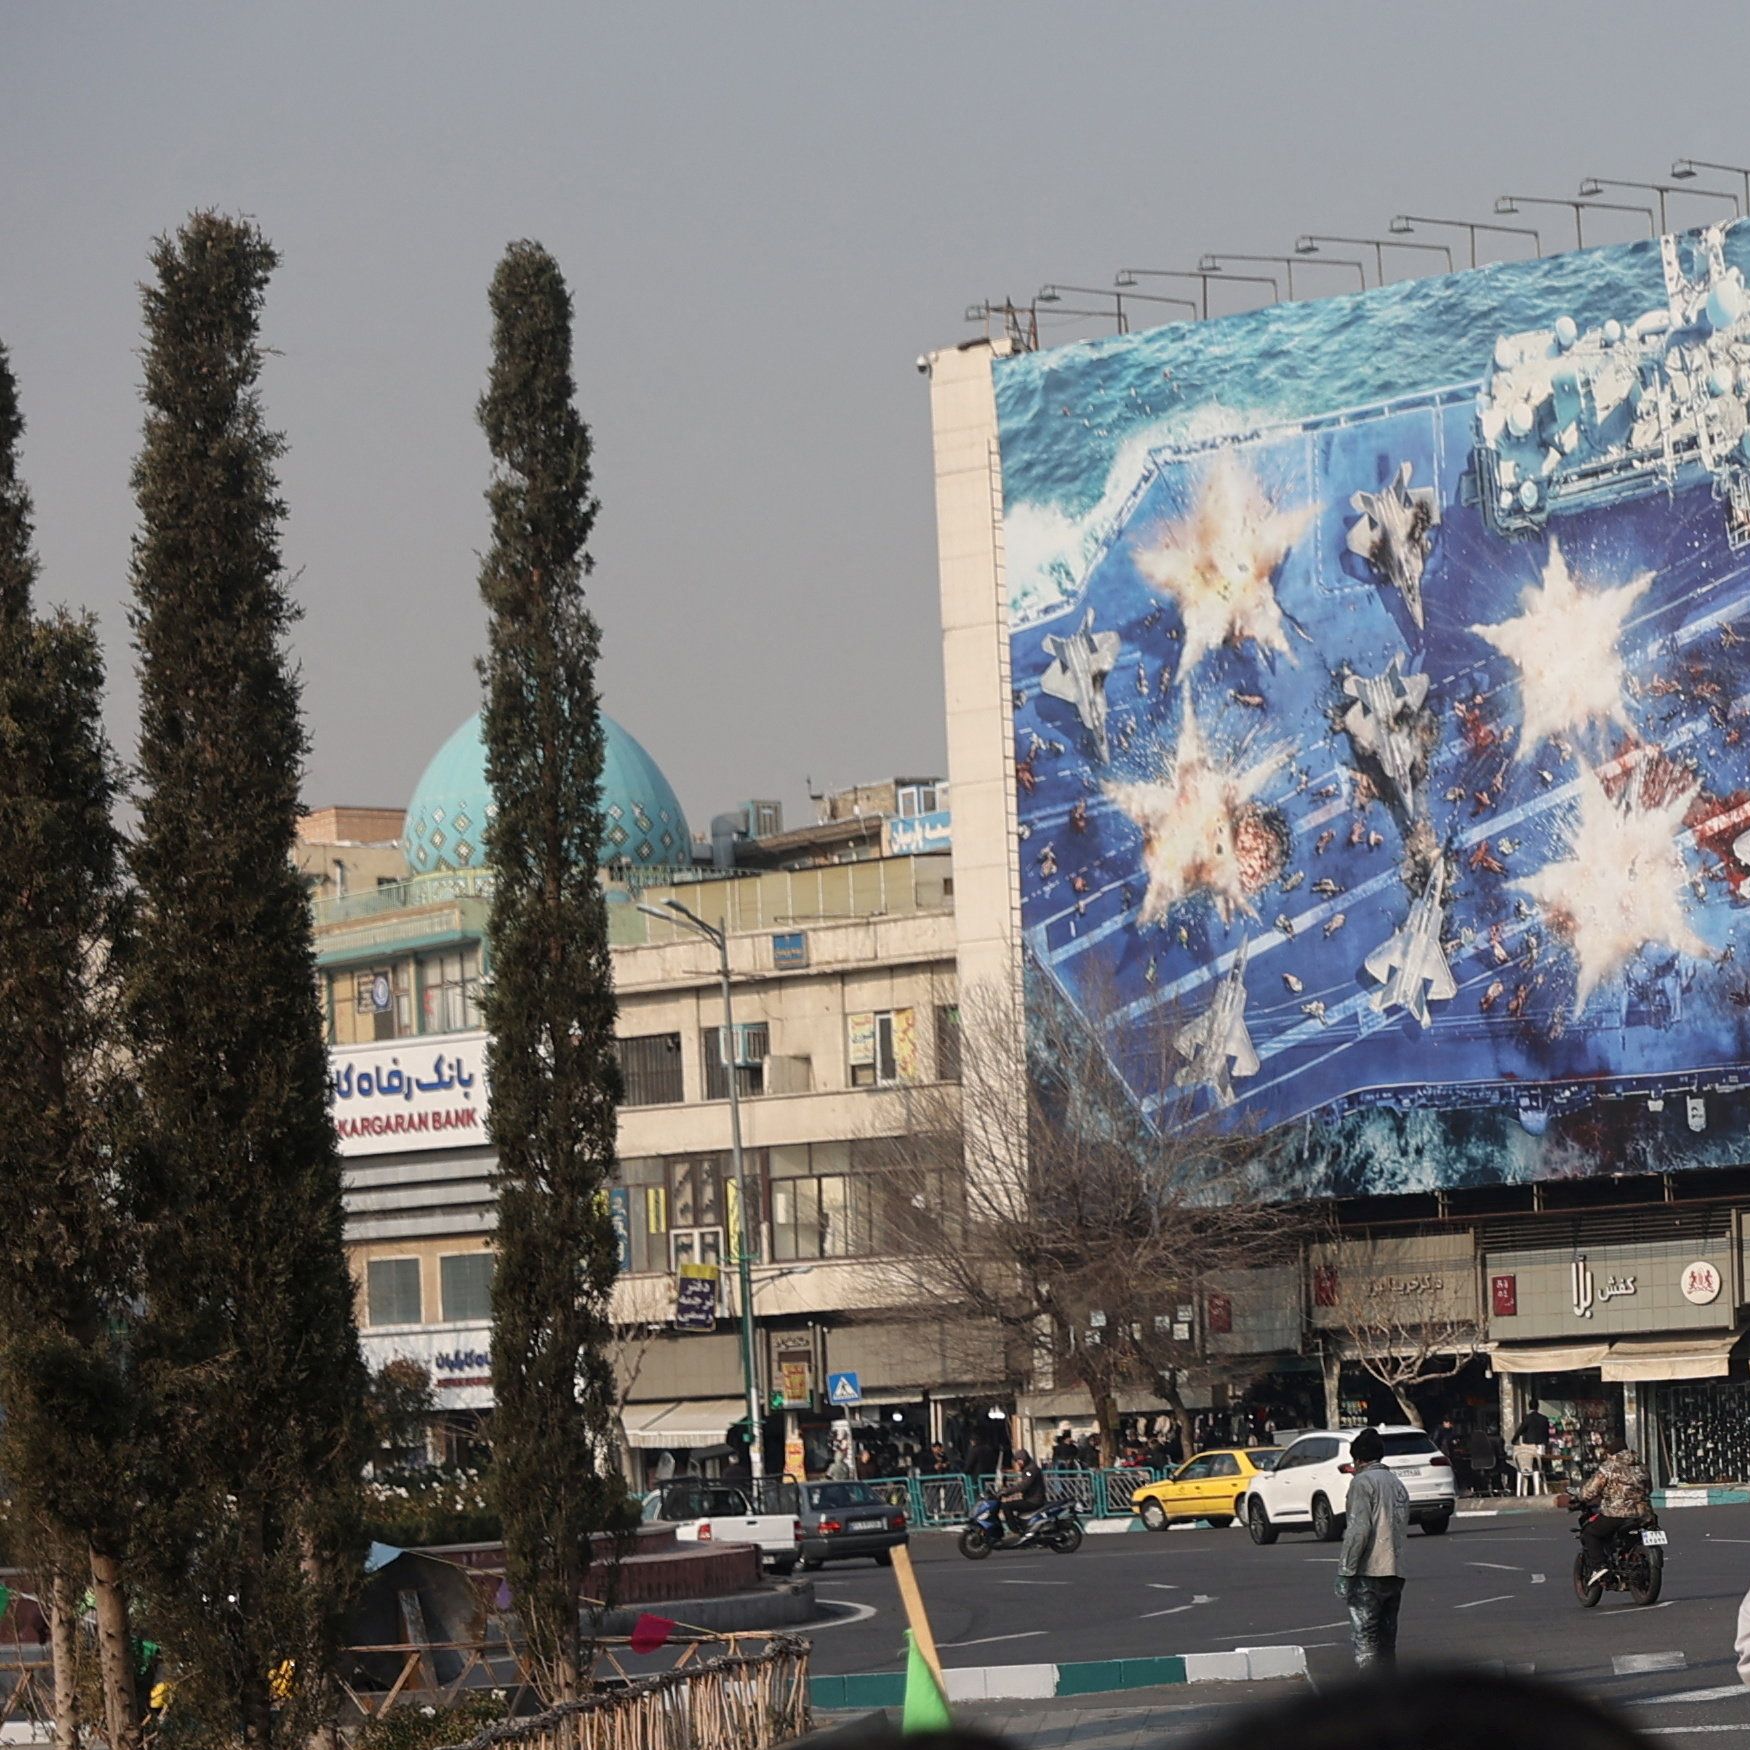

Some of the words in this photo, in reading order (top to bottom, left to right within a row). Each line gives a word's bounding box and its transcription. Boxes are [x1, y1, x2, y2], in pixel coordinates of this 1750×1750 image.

[357, 1057, 413, 1101] رفاه
[415, 1054, 474, 1100] بانک
[338, 1111, 428, 1137] KARGARAN
[432, 1107, 477, 1130] BANK
[686, 1280, 711, 1295] دفتر
[1598, 1276, 1637, 1302] کفش
[678, 1295, 714, 1311] ترجمه
[678, 1311, 713, 1325] رسمی
